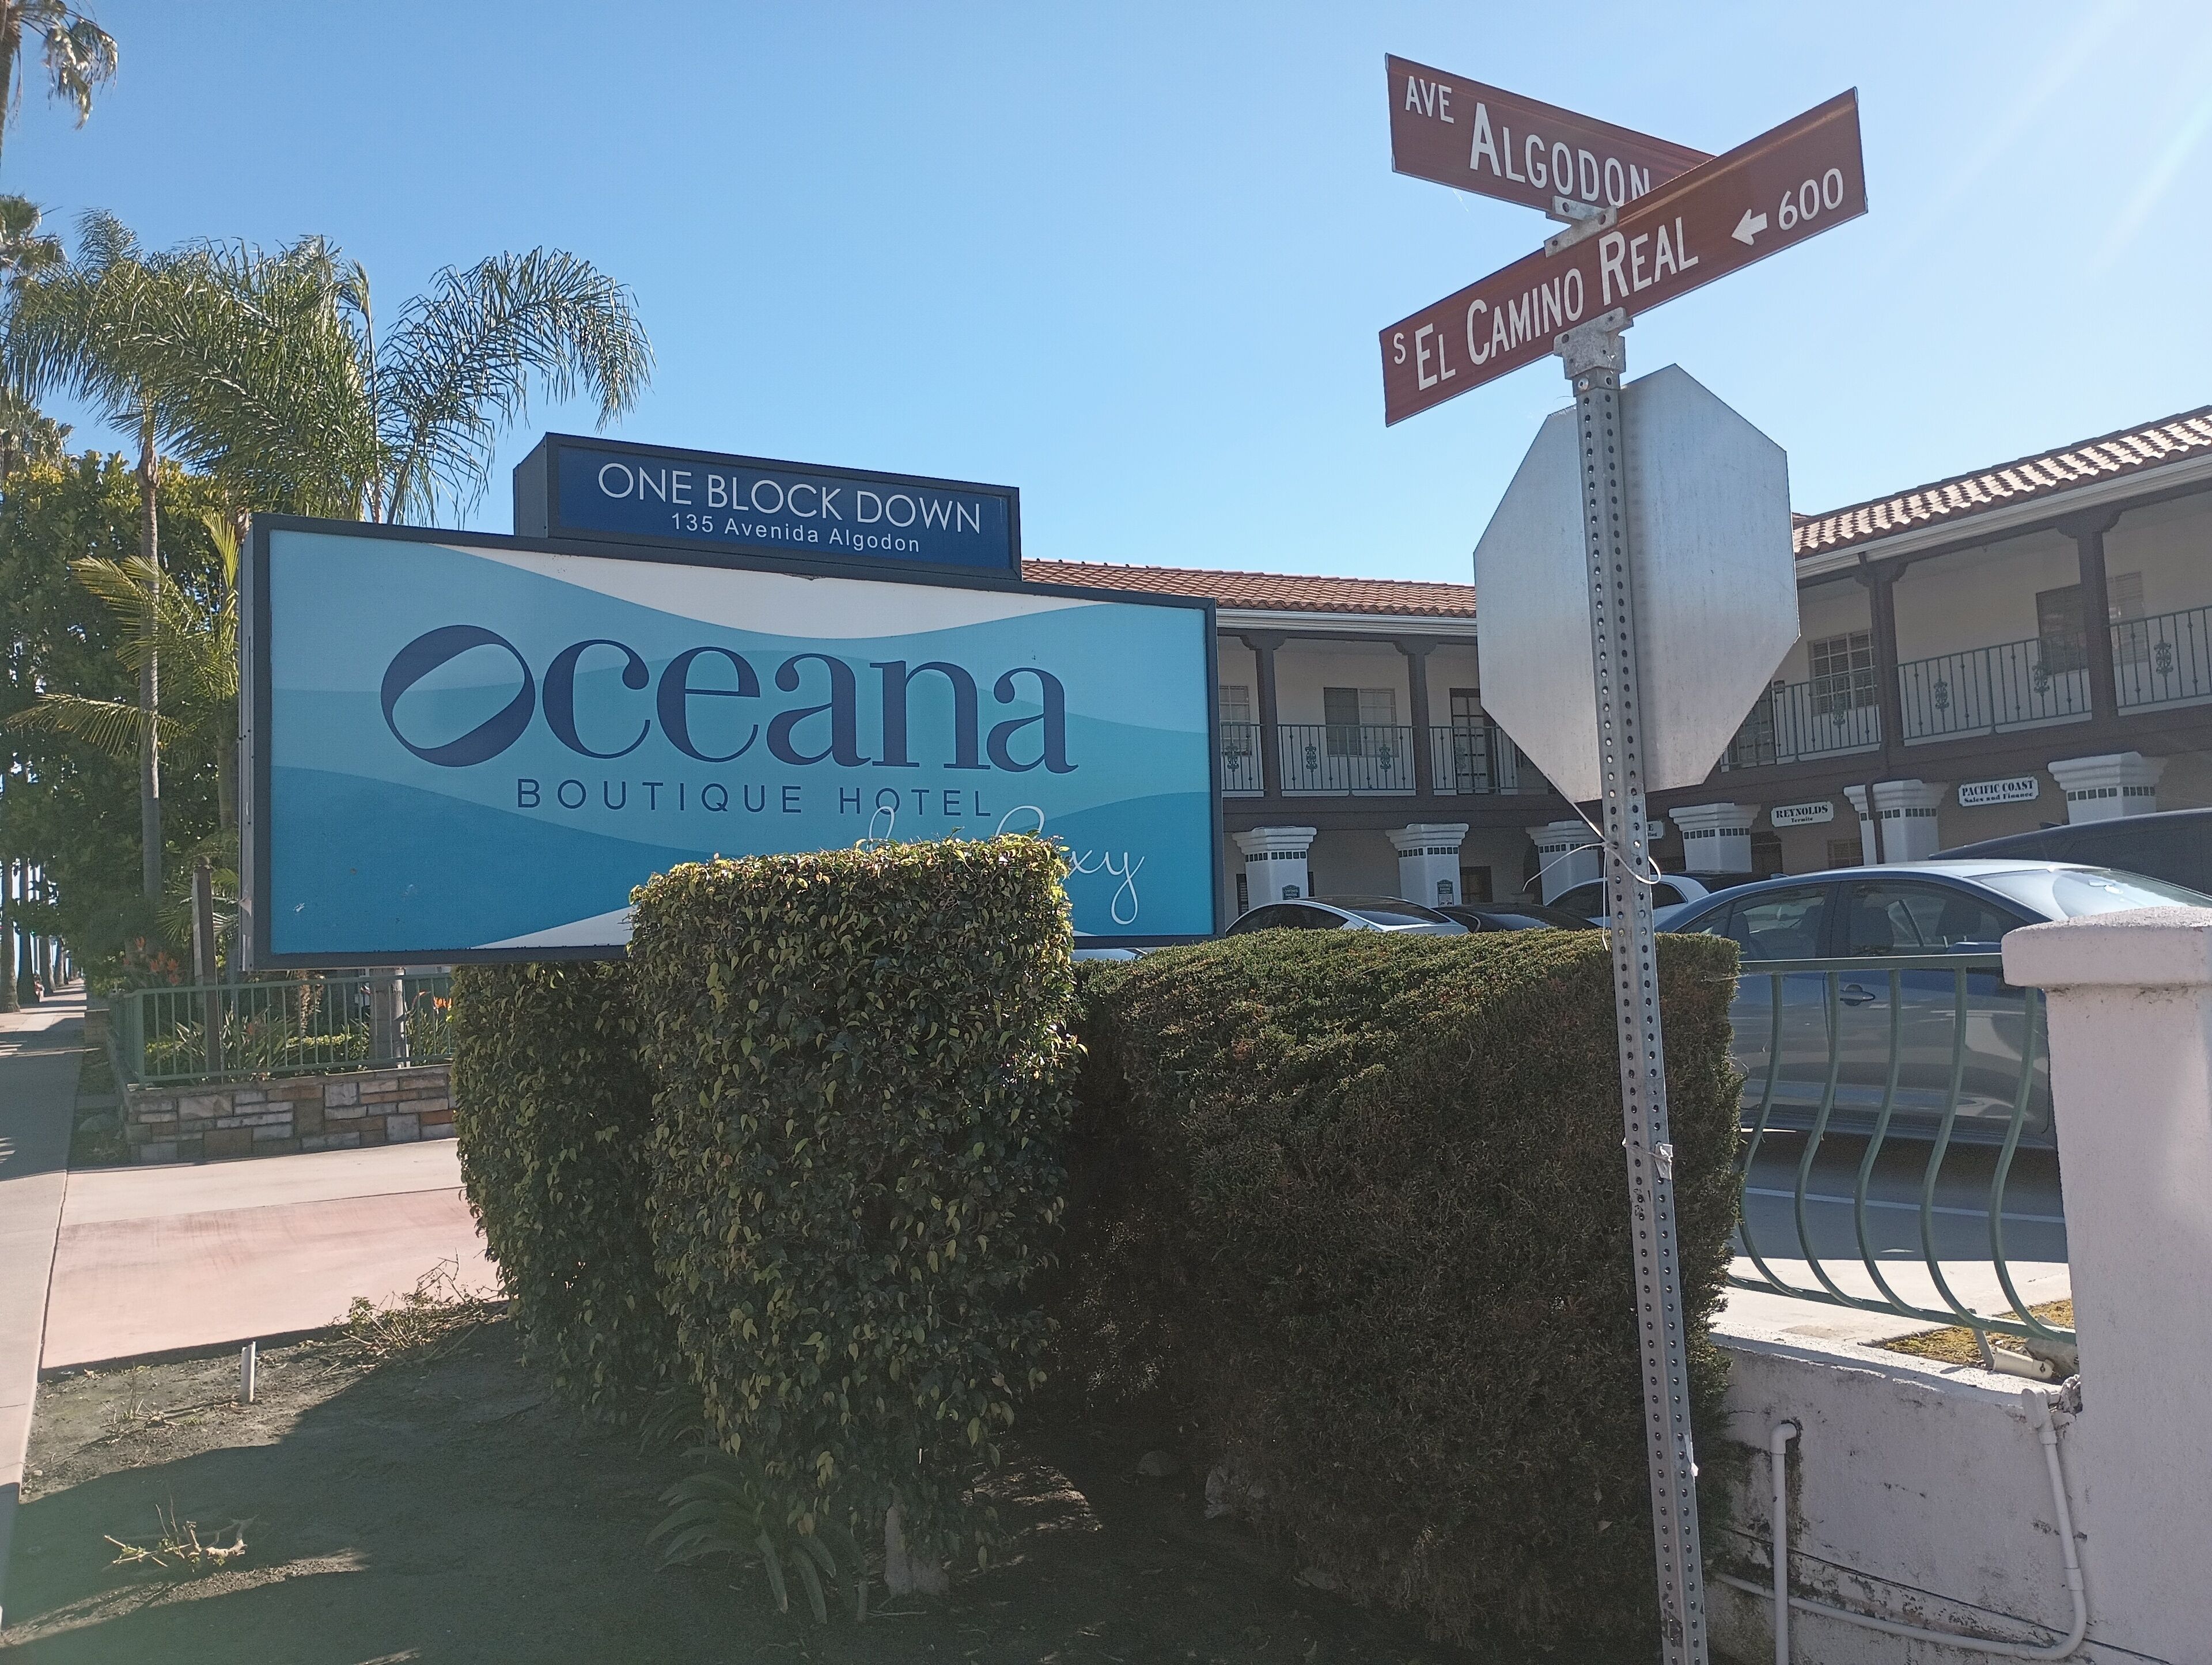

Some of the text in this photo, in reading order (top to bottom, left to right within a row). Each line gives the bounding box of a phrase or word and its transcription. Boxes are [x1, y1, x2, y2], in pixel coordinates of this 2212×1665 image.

[1405, 75, 1651, 208] AVE ALGODON
[1393, 168, 1844, 392] S EL CAMINO REAL 600
[597, 462, 980, 534] ONE BLOCK DOWN
[671, 512, 920, 552] 135 Avenida Algodon
[517, 777, 991, 817] BOUTIQUE HOTEL
[1962, 780, 2033, 797] PACIFIC COAST
[1776, 805, 1828, 818] REYNOLDS
